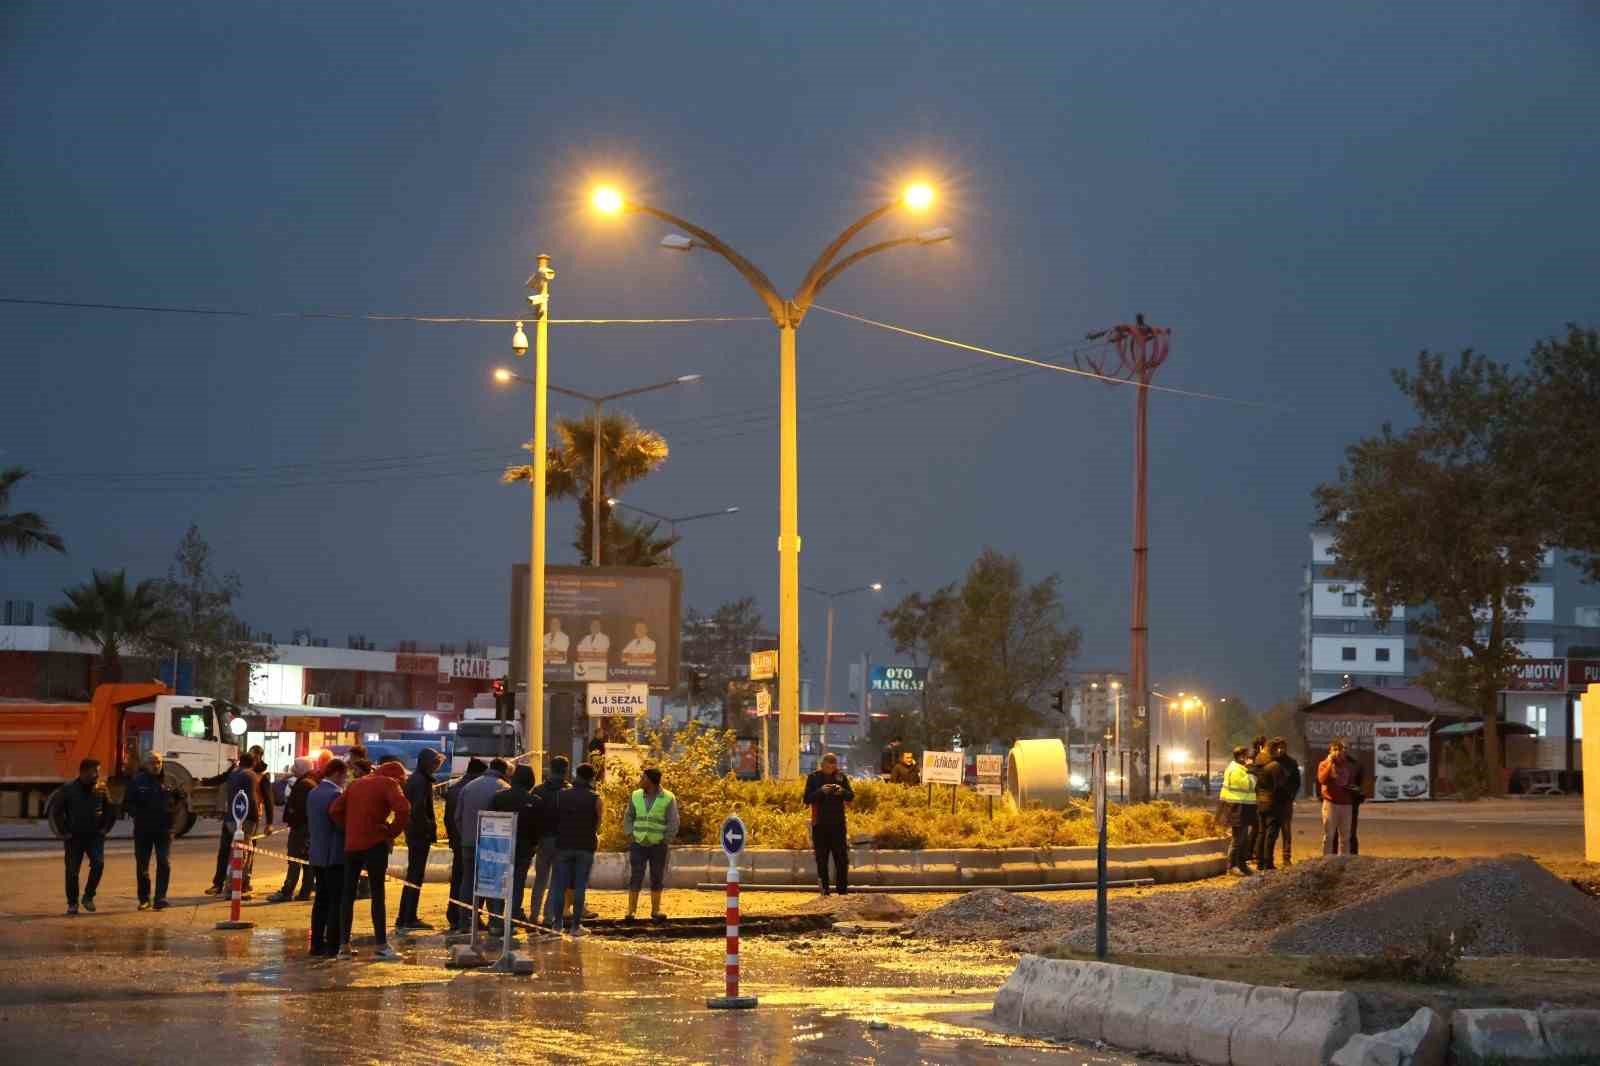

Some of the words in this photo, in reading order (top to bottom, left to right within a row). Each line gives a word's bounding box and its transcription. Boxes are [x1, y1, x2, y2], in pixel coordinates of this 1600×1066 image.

[453, 658, 489, 678] ECZANE
[886, 668, 913, 679] OTO
[1584, 666, 1600, 681] PU
[611, 696, 644, 704] SEZAL
[1334, 720, 1352, 737] OTO
